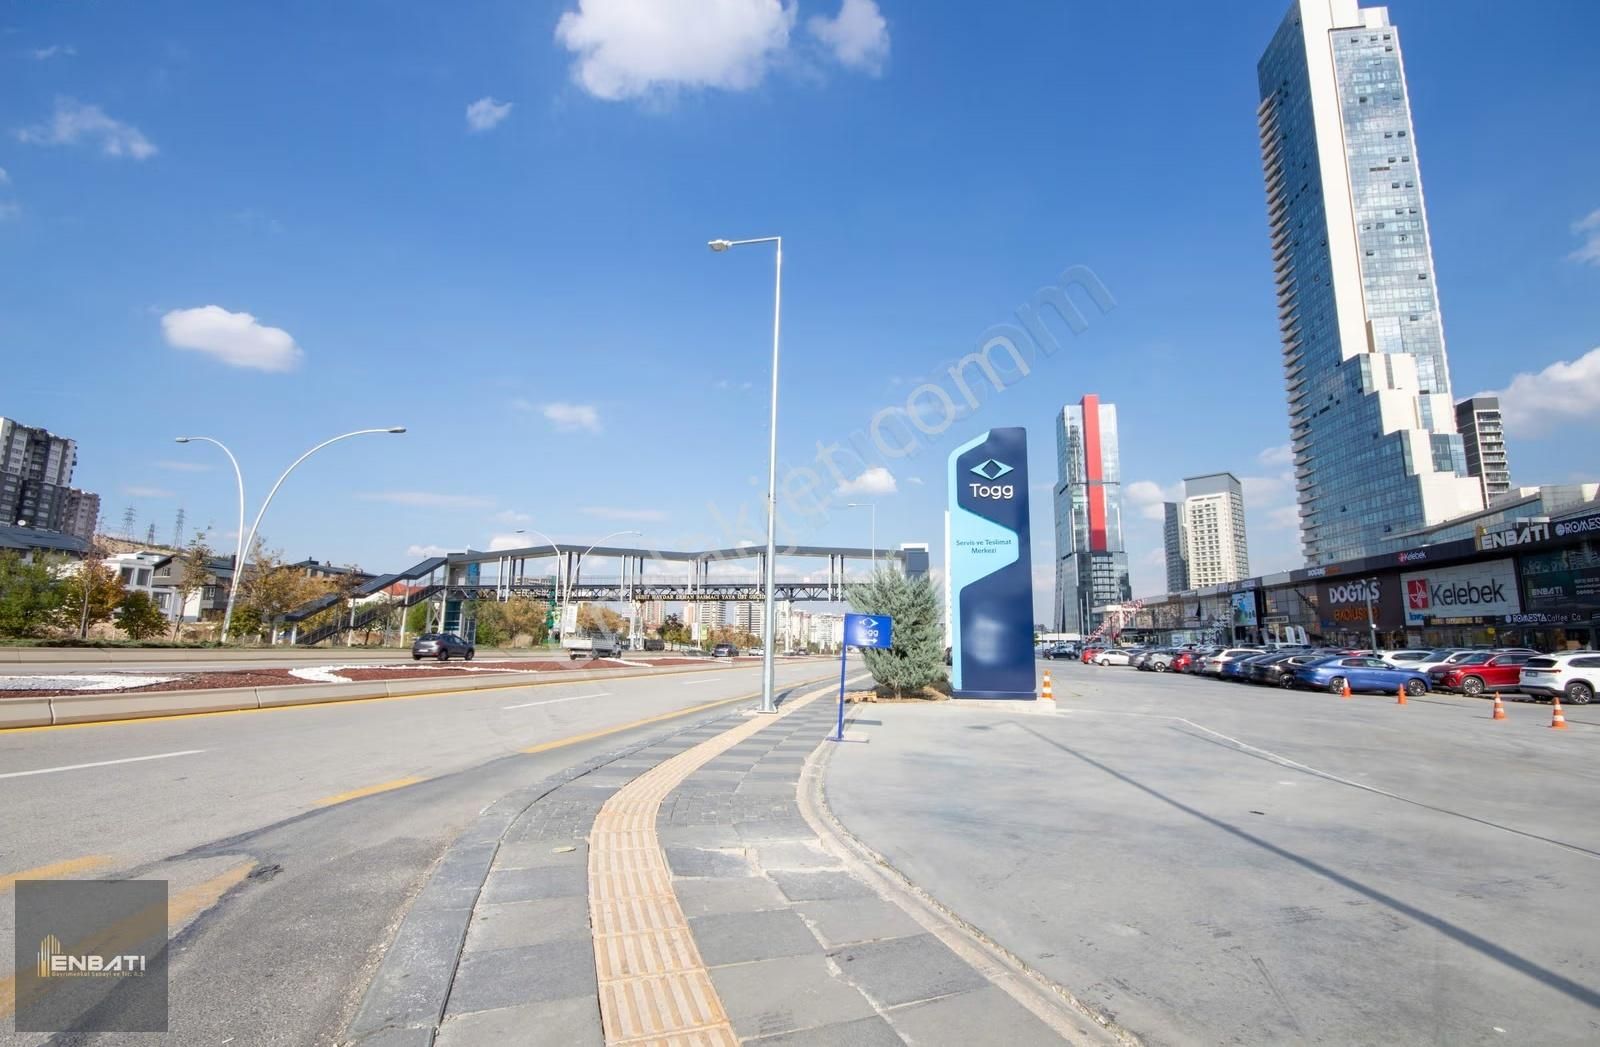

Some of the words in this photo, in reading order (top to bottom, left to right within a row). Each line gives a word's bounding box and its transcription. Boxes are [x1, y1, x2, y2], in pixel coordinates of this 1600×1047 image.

[969, 484, 1014, 499] Togg
[985, 538, 1012, 546] Teslimat
[1481, 524, 1550, 550] ENBATI
[1430, 579, 1506, 606] Kelebek
[1532, 586, 1563, 596] ENBATI
[1513, 613, 1547, 623] ROMESTA
